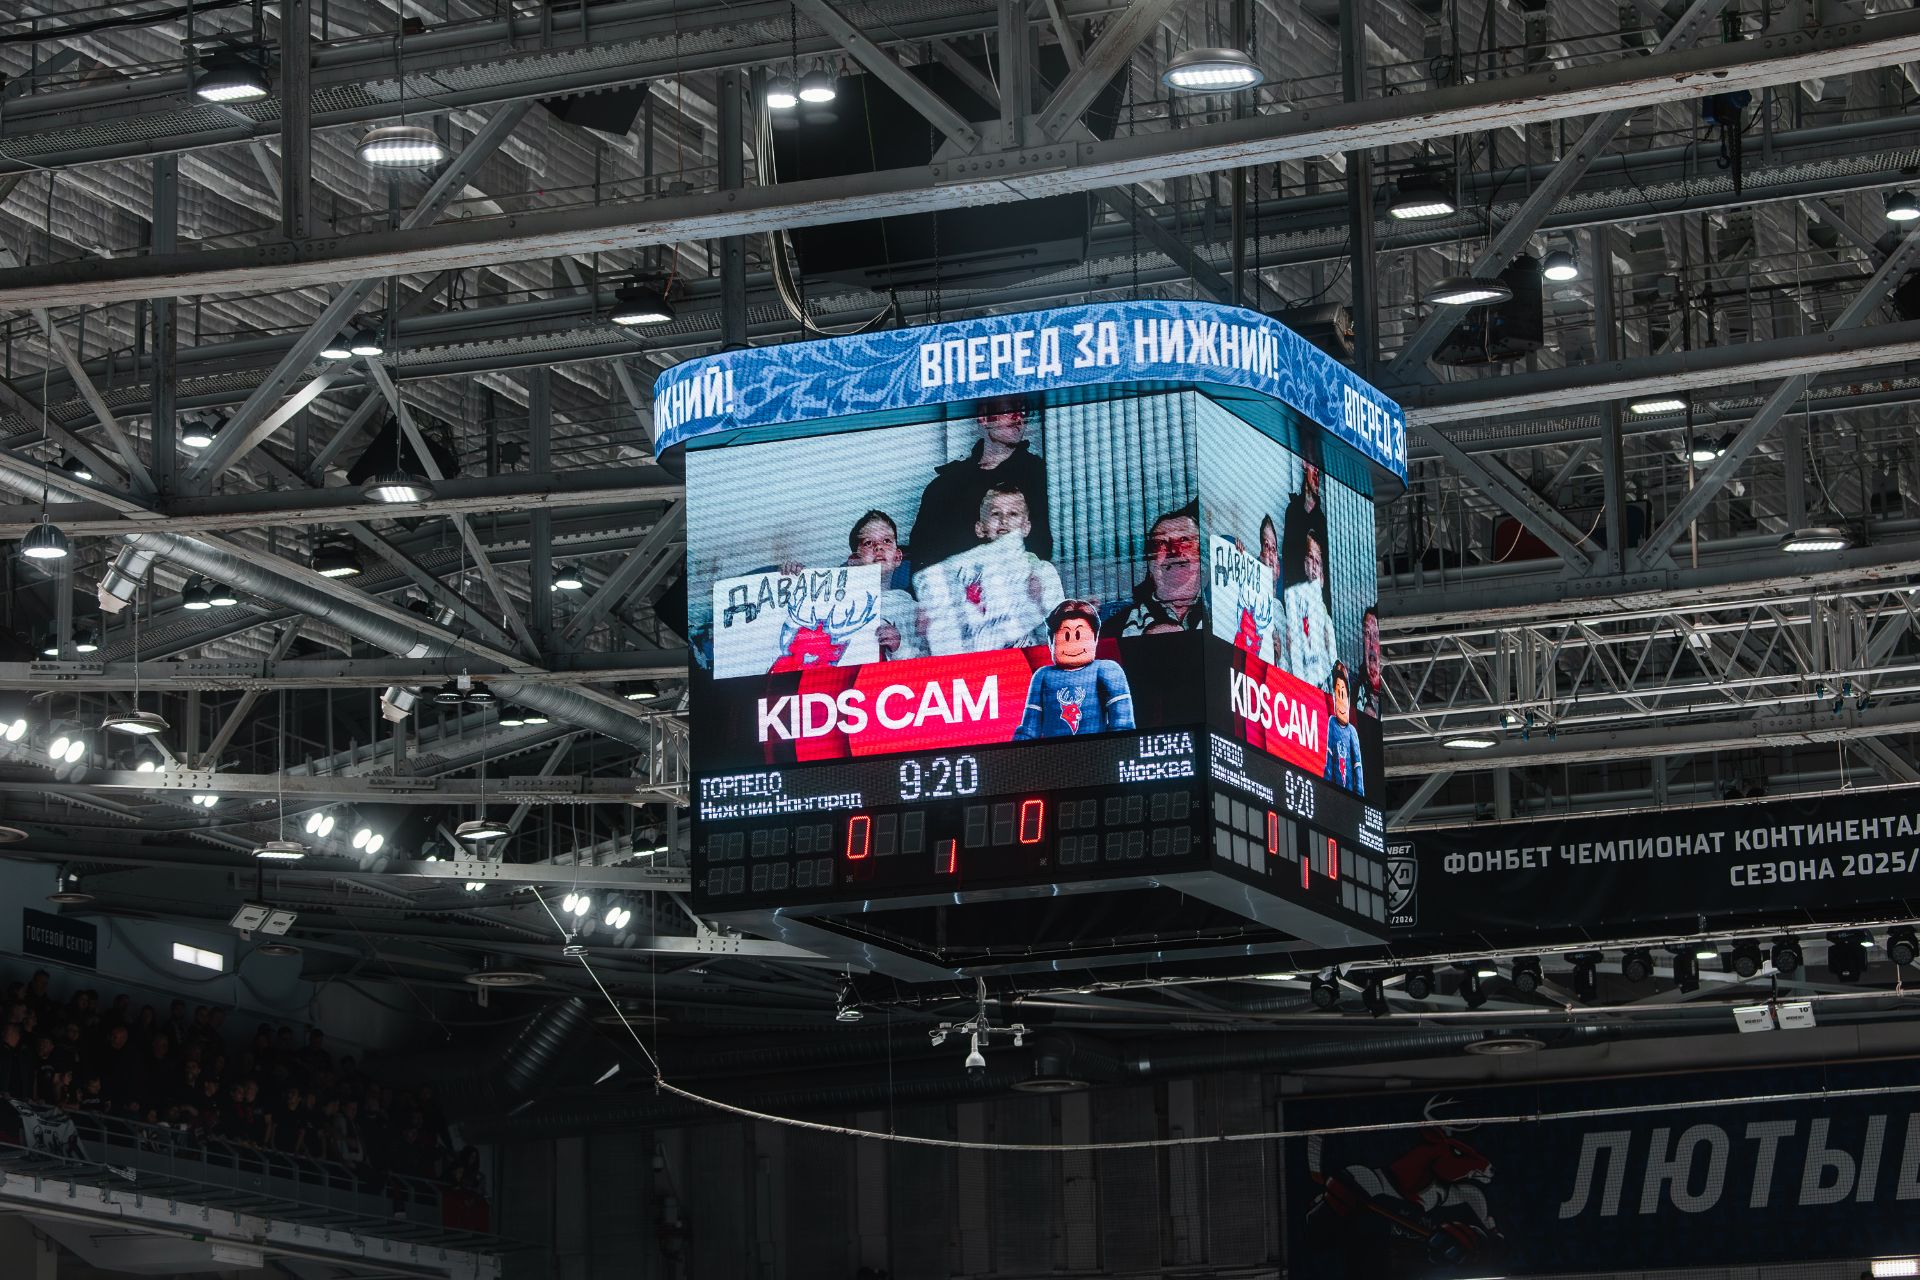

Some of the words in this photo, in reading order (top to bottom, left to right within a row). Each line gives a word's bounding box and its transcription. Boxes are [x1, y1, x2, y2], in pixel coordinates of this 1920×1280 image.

[919, 327, 1063, 388] ВПЕРЕД
[1073, 320, 1120, 368] ЗА
[1134, 319, 1279, 381] НИЖНИЙ!
[1343, 384, 1392, 460] ВПЕРЕД
[722, 568, 848, 627] ДАВАЙ!
[757, 689, 868, 742] KIDS
[875, 675, 999, 730] CAM
[1230, 667, 1273, 731] KIDS
[1273, 692, 1319, 753] CAM
[1139, 732, 1194, 758] ЦСКА
[700, 772, 782, 800] ТОРПЕДО
[900, 755, 978, 800] 9:20
[1118, 759, 1194, 783] Москва
[1285, 770, 1315, 820] 9:20
[847, 815, 871, 860] 0
[1019, 799, 1044, 844] 0
[1444, 846, 1552, 874] ФОНБЕТ
[1560, 832, 1725, 865] ЧЕМПИОНАТ
[1730, 857, 1834, 887] СЕЗОНА
[1842, 848, 1920, 877] 2025/
[1389, 916, 1413, 925] /2026
